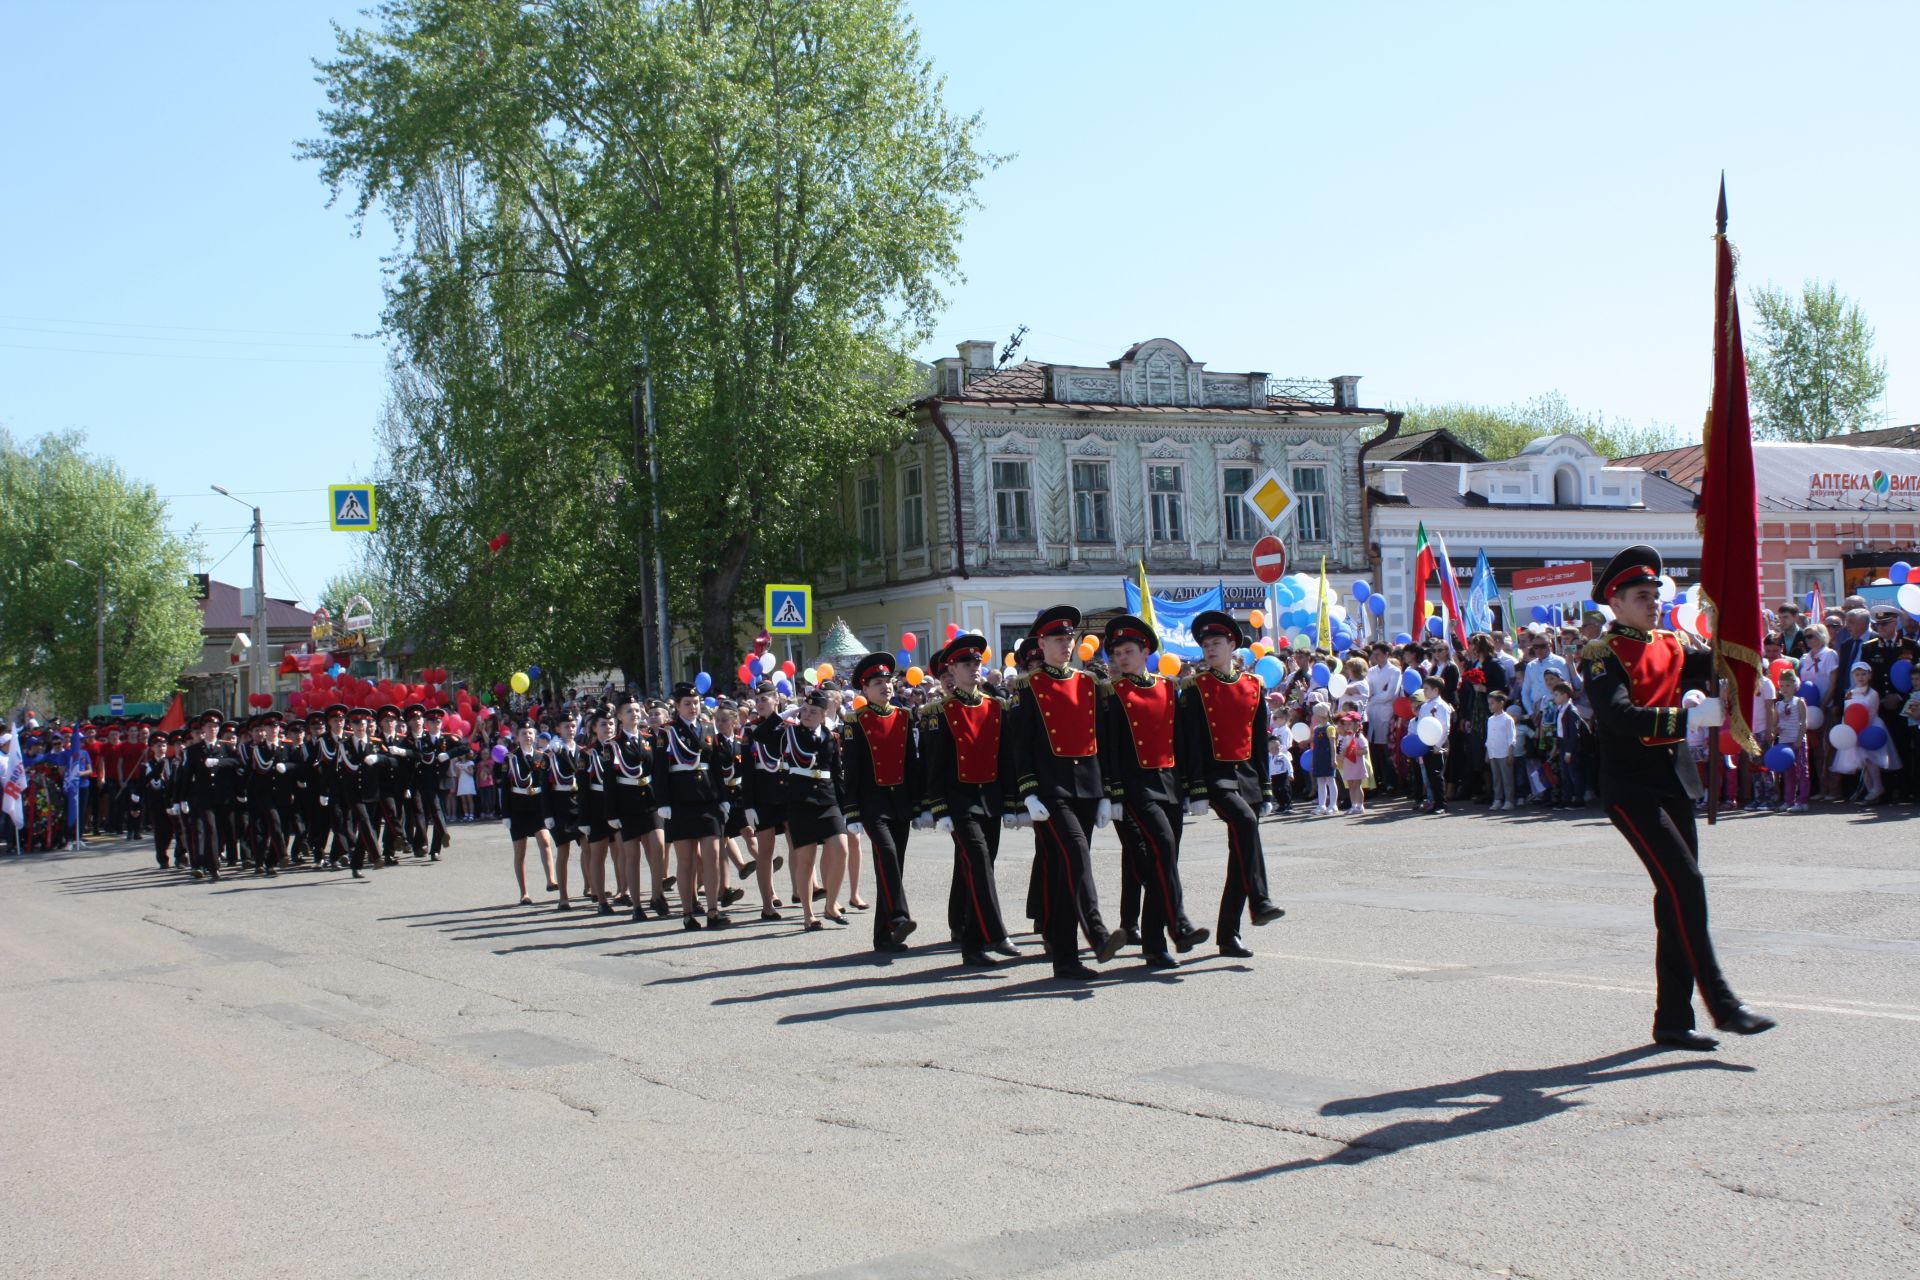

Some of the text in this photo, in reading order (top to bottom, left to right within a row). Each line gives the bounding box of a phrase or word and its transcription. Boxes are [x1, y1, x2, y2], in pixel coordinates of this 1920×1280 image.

[1811, 473, 1870, 489] АПТЕКА
[1671, 567, 1689, 577] BAR
[1223, 587, 1264, 601] ХОЛДИ
